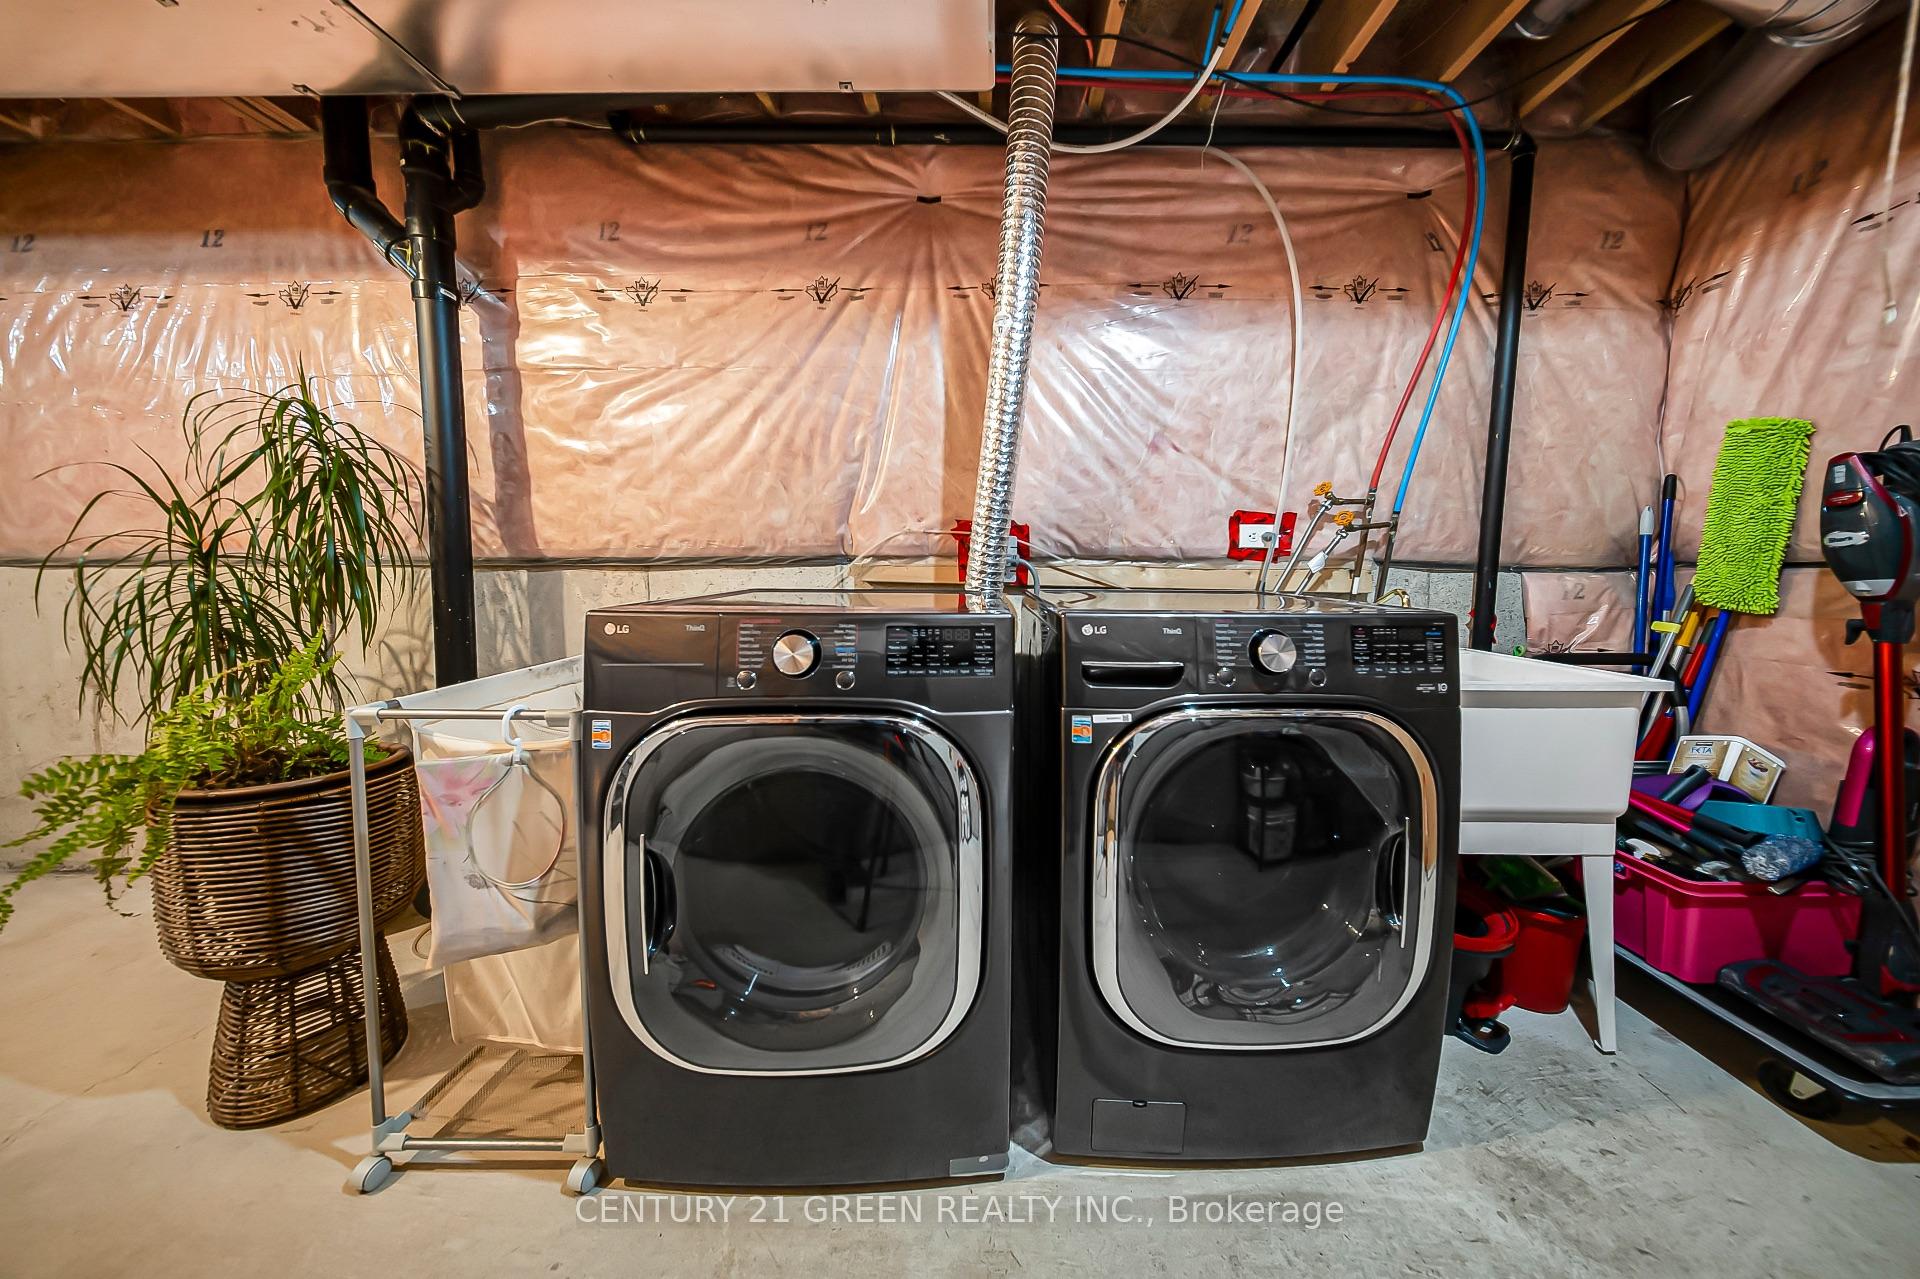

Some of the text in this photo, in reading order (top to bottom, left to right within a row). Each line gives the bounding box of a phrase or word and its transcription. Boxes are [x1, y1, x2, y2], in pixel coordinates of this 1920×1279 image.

[199, 229, 225, 249] 12
[599, 221, 621, 242] 12
[805, 222, 830, 242] 12
[1227, 222, 1255, 246] 12
[1600, 230, 1625, 250] 12
[11, 233, 36, 253] 12
[685, 624, 706, 632] ThinQ
[1162, 627, 1183, 635] ThinQ
[1691, 746, 1713, 755] FETA
